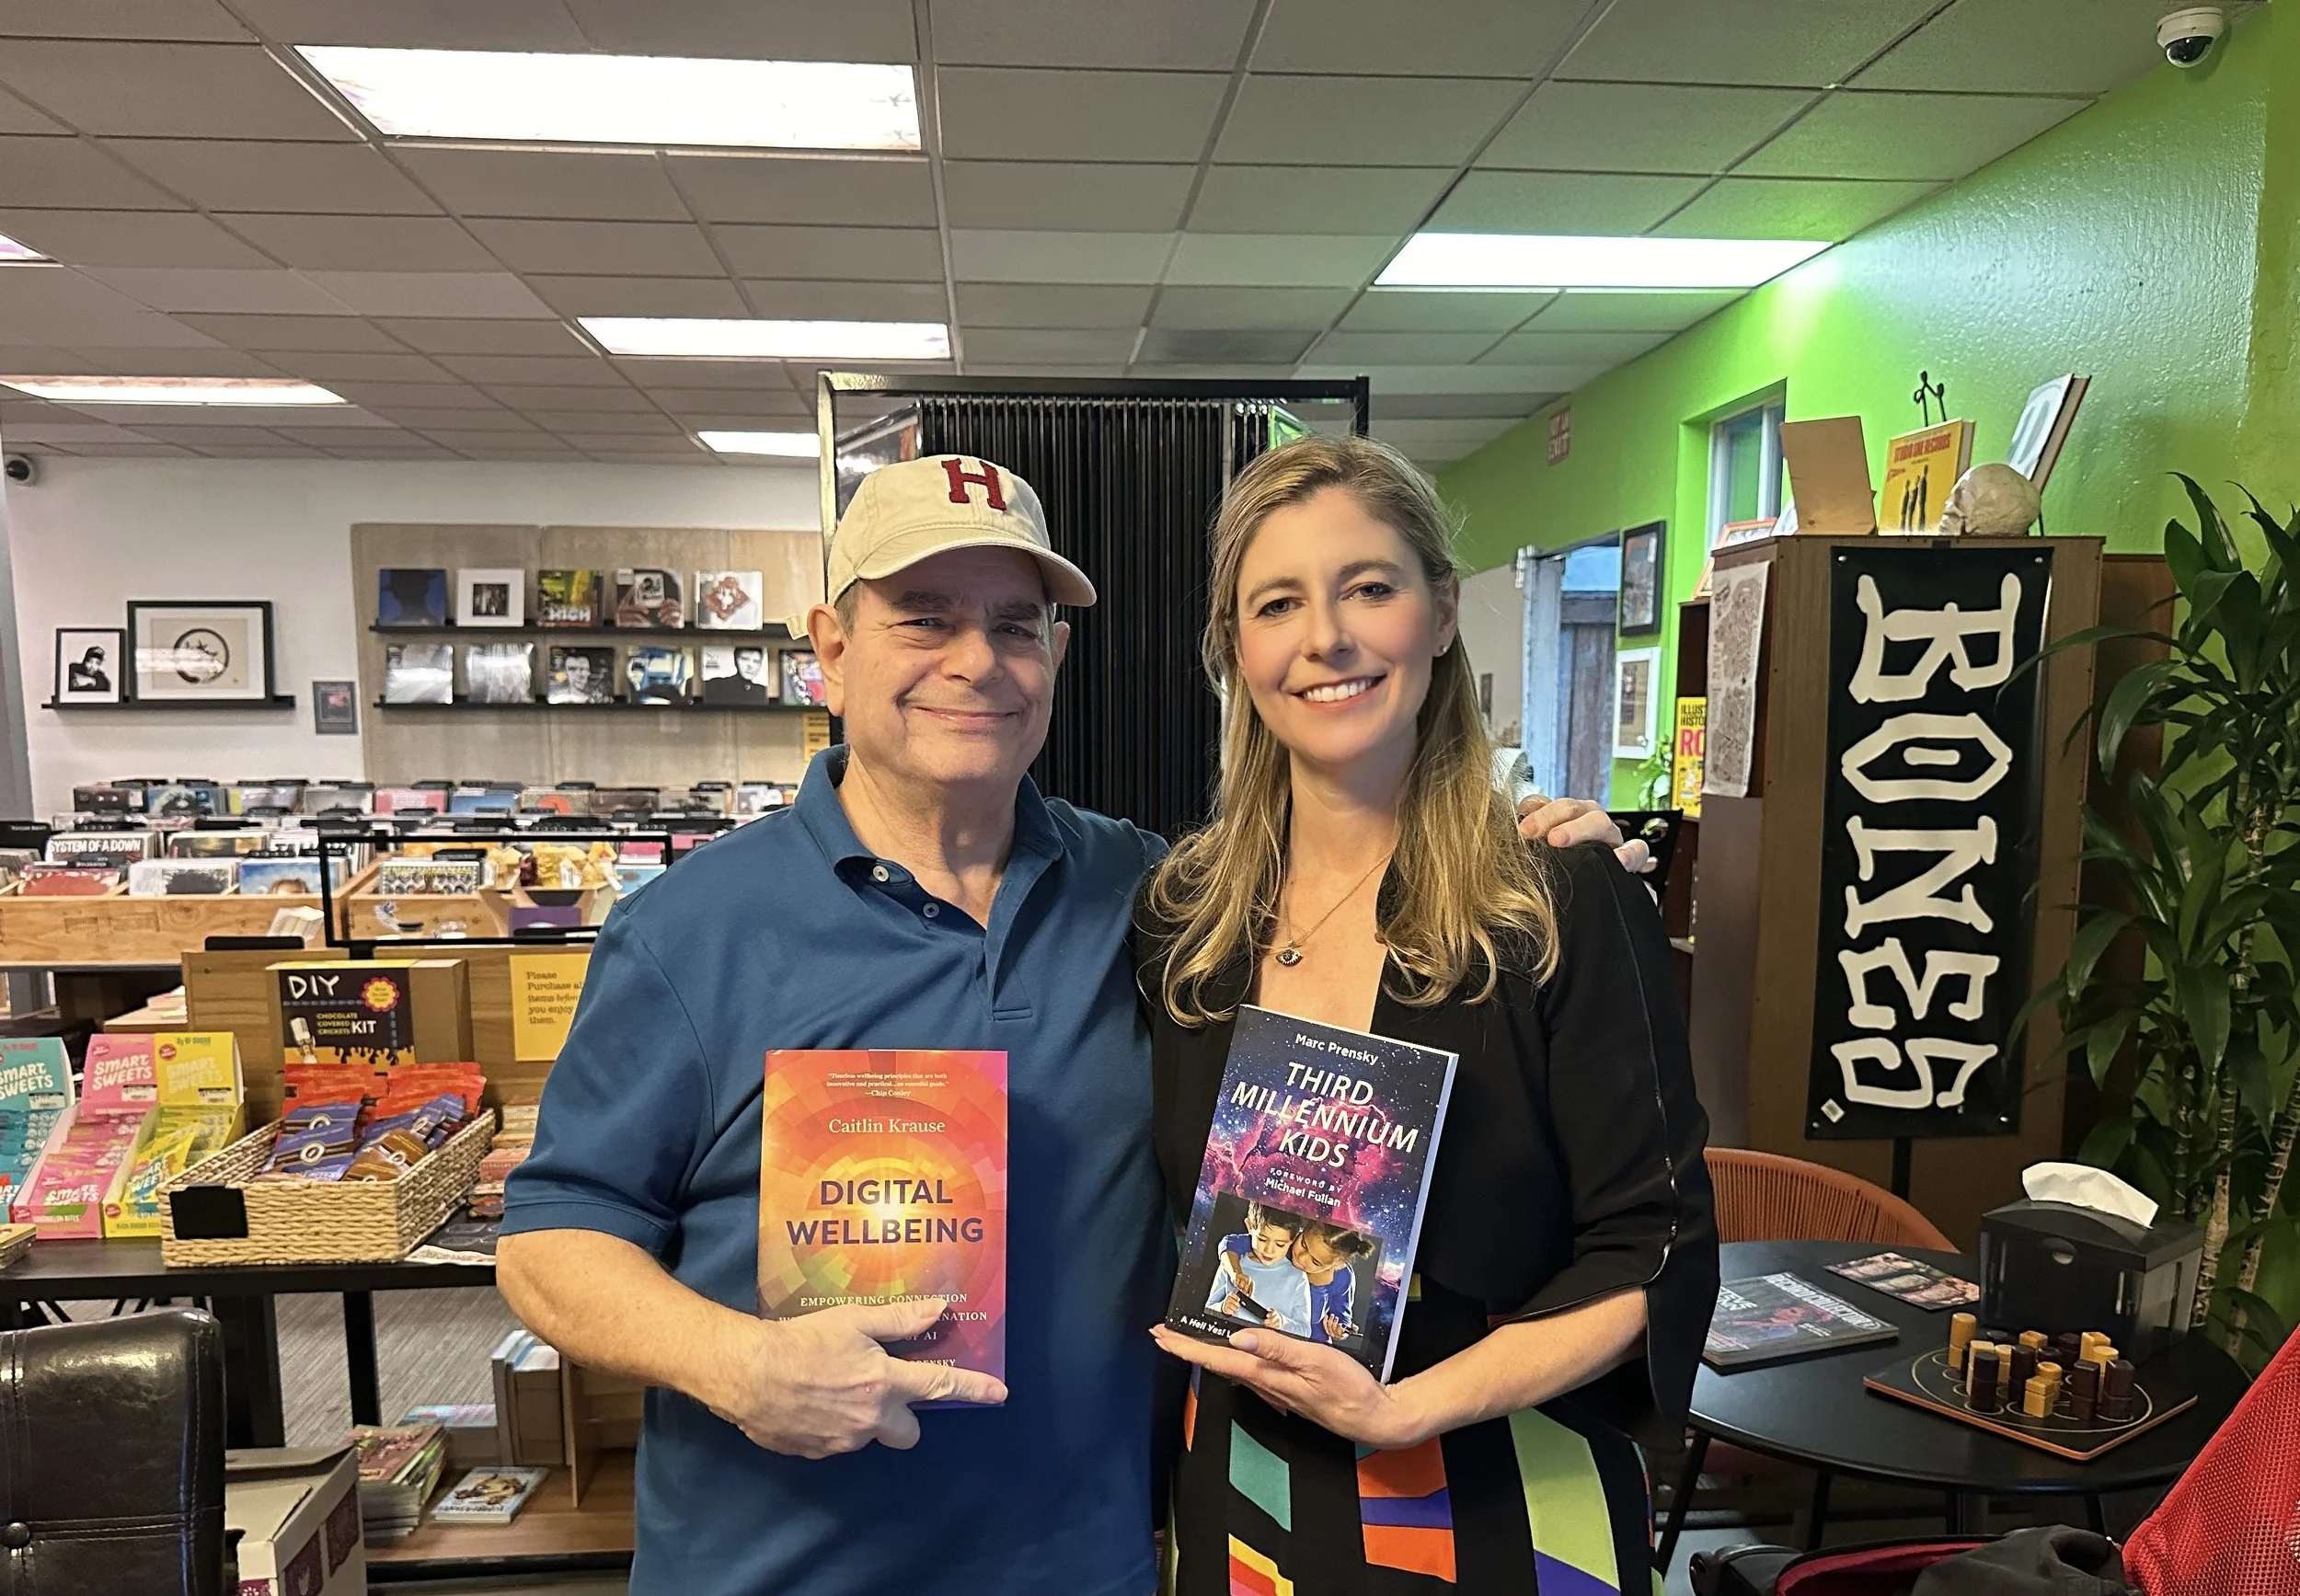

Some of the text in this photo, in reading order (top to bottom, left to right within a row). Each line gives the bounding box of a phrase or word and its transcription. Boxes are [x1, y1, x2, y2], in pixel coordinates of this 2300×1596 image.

[941, 458, 1006, 511] H
[51, 839, 141, 852] SYSTEM OF A DOWN
[1830, 573, 2021, 1109] BONES
[526, 970, 558, 980] Please
[527, 982, 571, 991] Purchase
[287, 975, 340, 1000] DIY
[529, 1006, 546, 1015] you
[351, 1020, 376, 1035] KIT
[1294, 1033, 1379, 1066] Marc Prensky
[95, 1054, 149, 1075] SMART
[93, 1066, 153, 1090] SWEETS
[1286, 1062, 1374, 1105] THIRD
[829, 1118, 946, 1133] Caitlin Krause
[1230, 1081, 1419, 1154] MILLENNIUM
[1279, 1128, 1349, 1168] KIDS
[821, 1179, 953, 1205] DIGITAL
[1265, 1177, 1341, 1208] Michael Fullan
[1270, 1167, 1343, 1194] FOREWORD BY
[786, 1217, 983, 1246] WELLBEING
[800, 1295, 885, 1307] EMPOWERING
[924, 1331, 937, 1340] AI
[1180, 1315, 1188, 1325] A
[1189, 1318, 1207, 1330] Hell
[1207, 1325, 1226, 1337] Yes!
